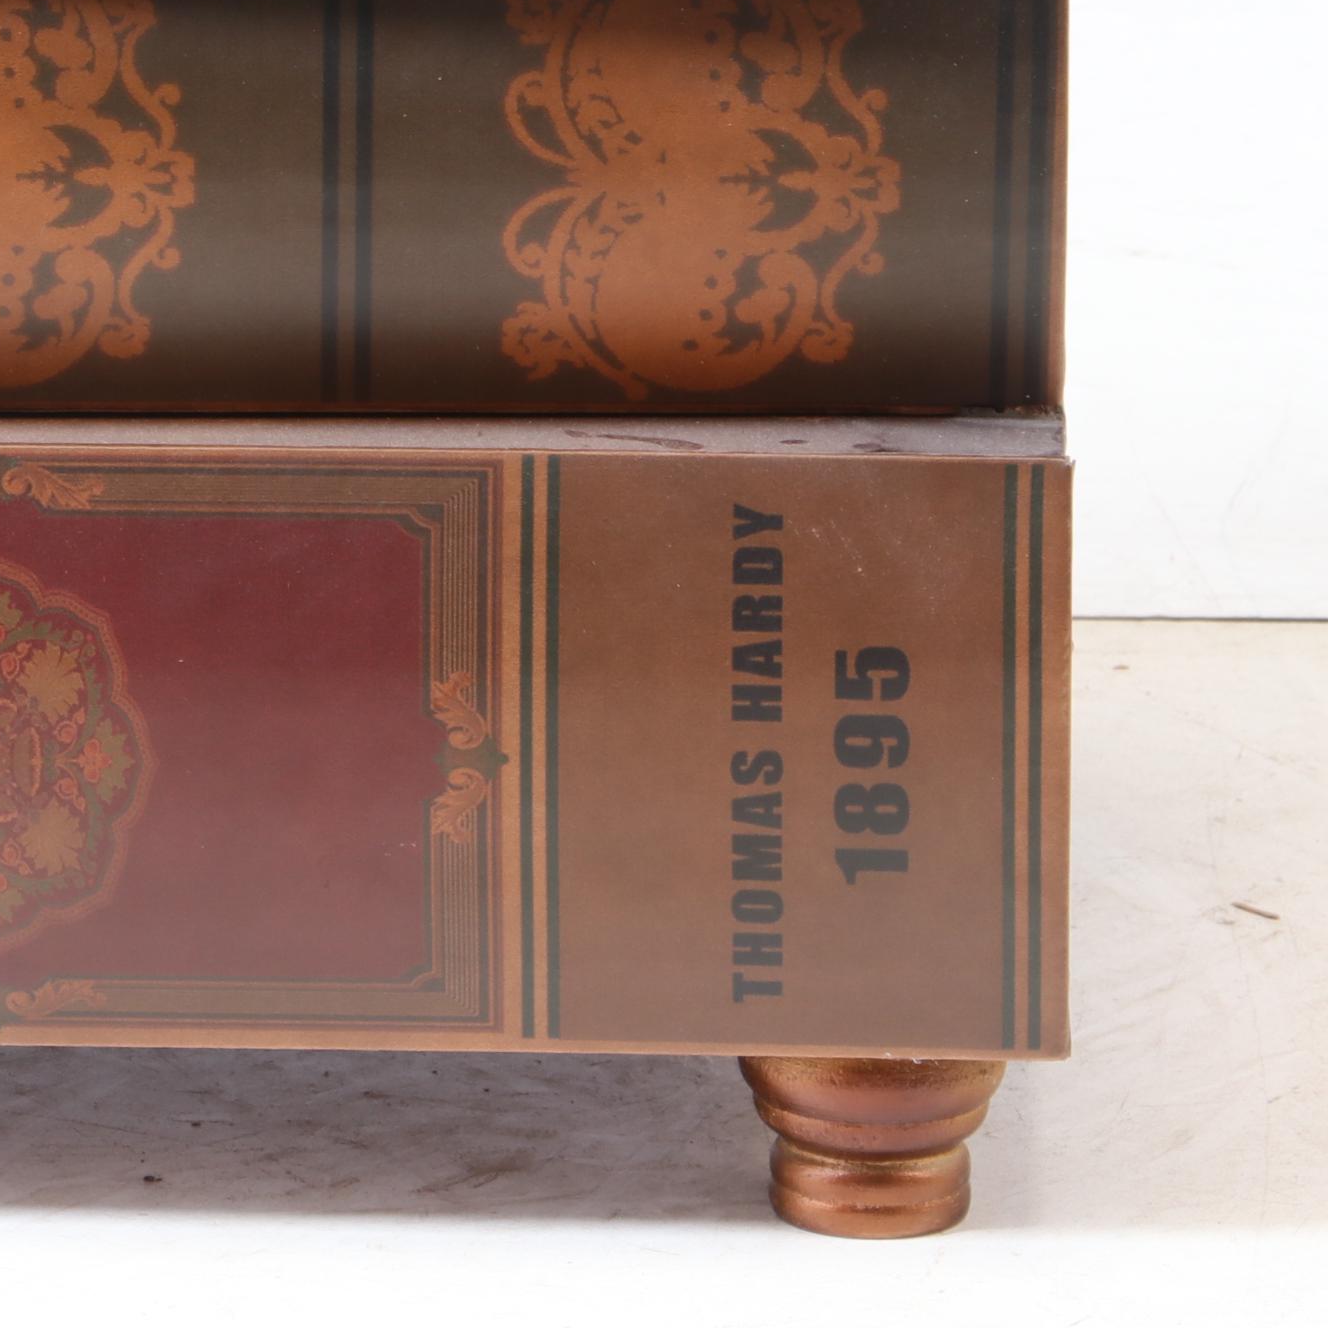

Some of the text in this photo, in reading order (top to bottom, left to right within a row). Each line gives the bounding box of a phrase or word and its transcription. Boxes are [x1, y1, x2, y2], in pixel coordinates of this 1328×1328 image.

[730, 502, 784, 1004] THOMAS HARDY
[833, 645, 911, 886] 1895
